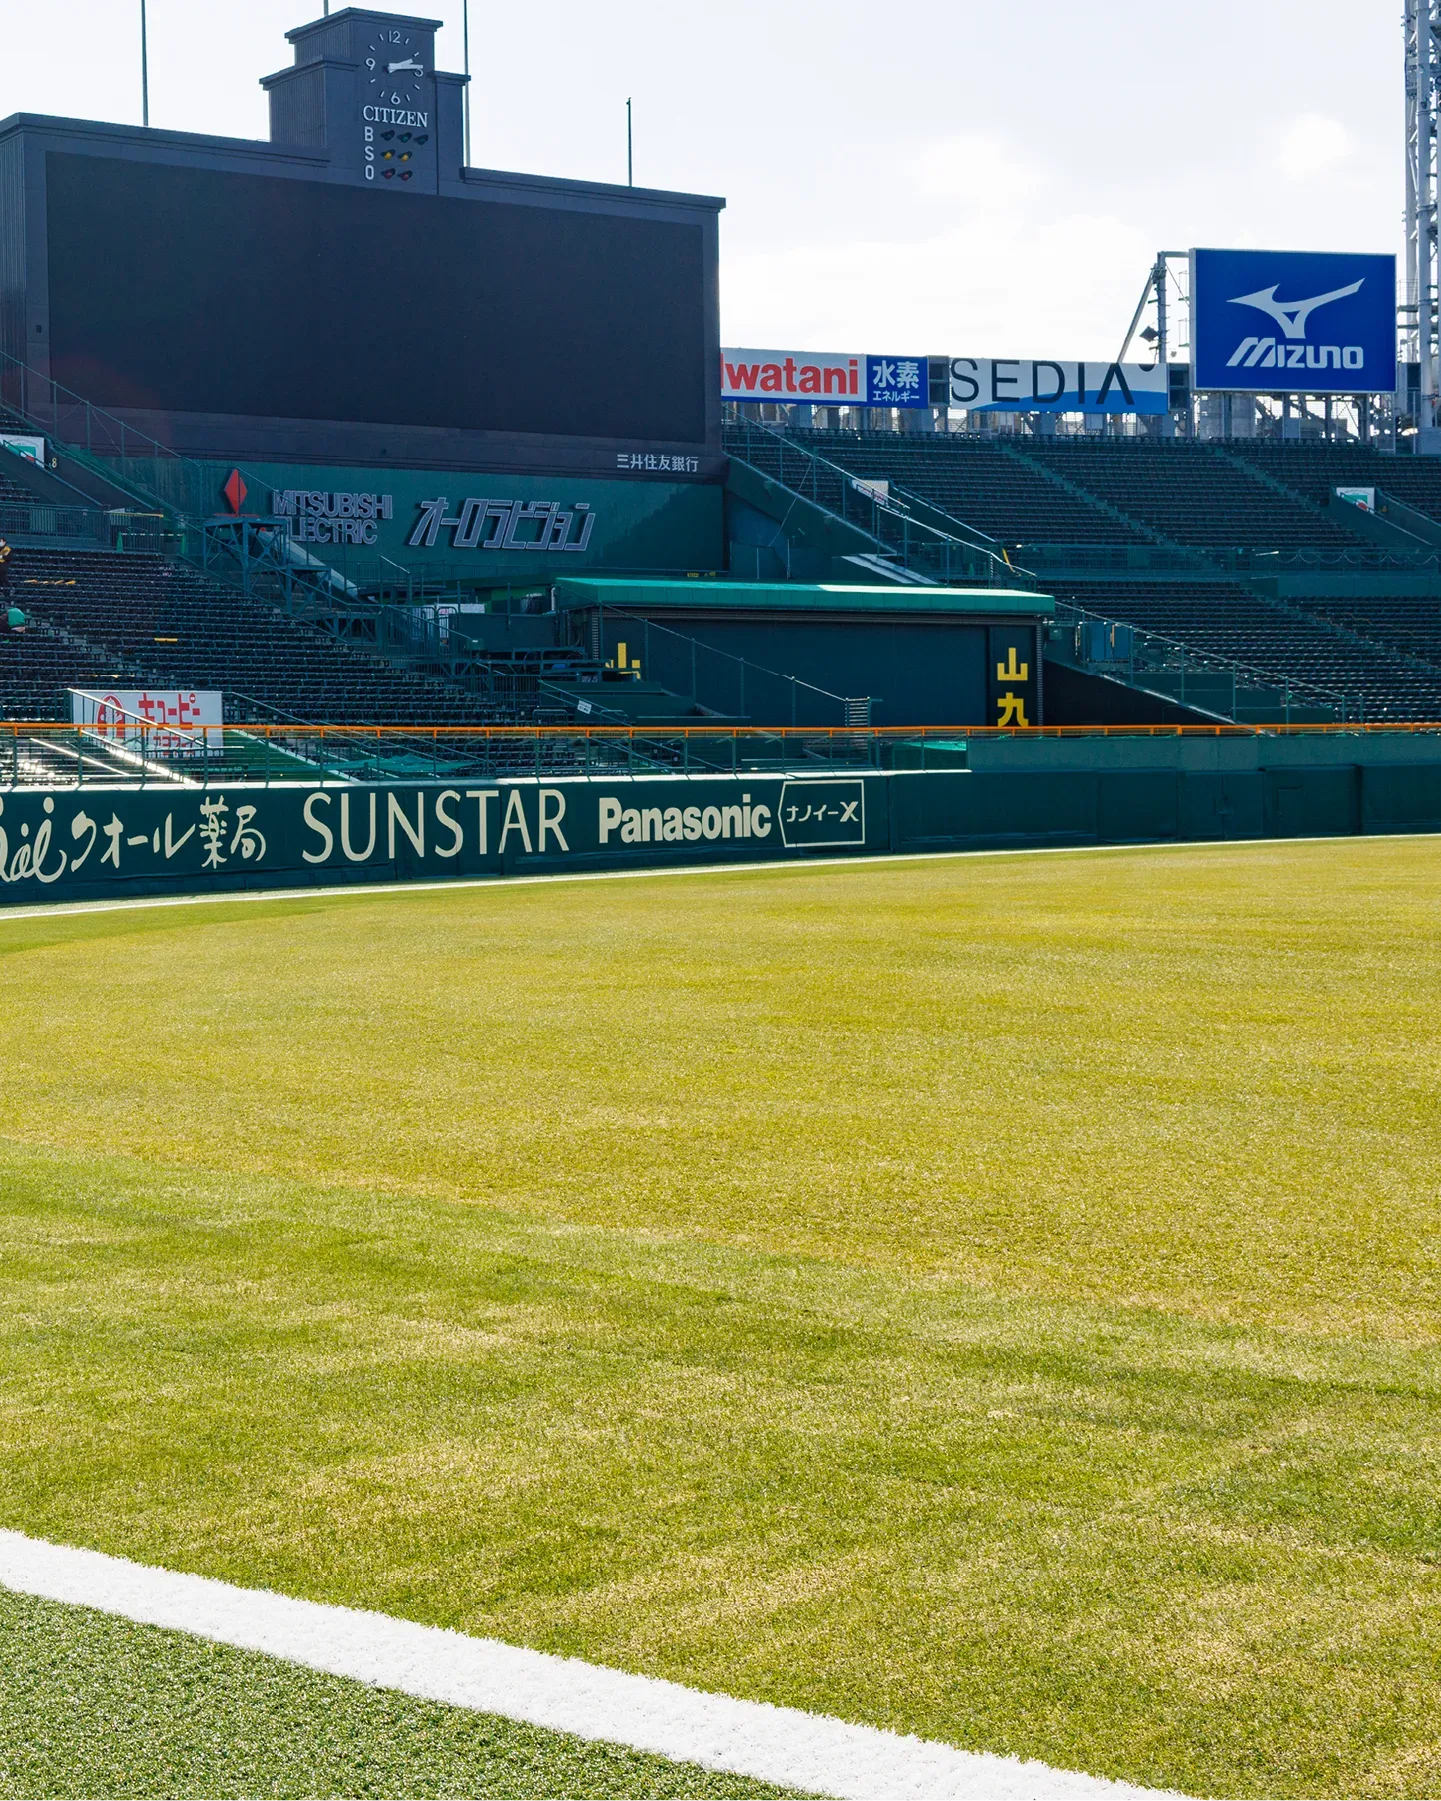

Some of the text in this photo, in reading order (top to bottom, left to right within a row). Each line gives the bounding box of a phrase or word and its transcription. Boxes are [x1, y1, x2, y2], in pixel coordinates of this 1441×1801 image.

[388, 30, 401, 44] 12
[365, 57, 376, 71] 9
[390, 91, 401, 105] 6
[363, 105, 428, 128] CITIZEN
[364, 126, 374, 142] B
[364, 145, 375, 161] S
[872, 360, 920, 389] 水素
[950, 358, 1135, 405] SEDIA
[872, 390, 920, 402] エネルギー
[617, 453, 699, 472] 三井住友銀行
[273, 490, 393, 519] MITSUBISHI
[274, 516, 378, 545] LECTRIC
[409, 497, 596, 551] オーロラビジョン
[997, 647, 1029, 728] 山九
[302, 789, 570, 864] SUNSTAR
[599, 793, 772, 844] Panasonic
[70, 795, 266, 873] クオール薬局
